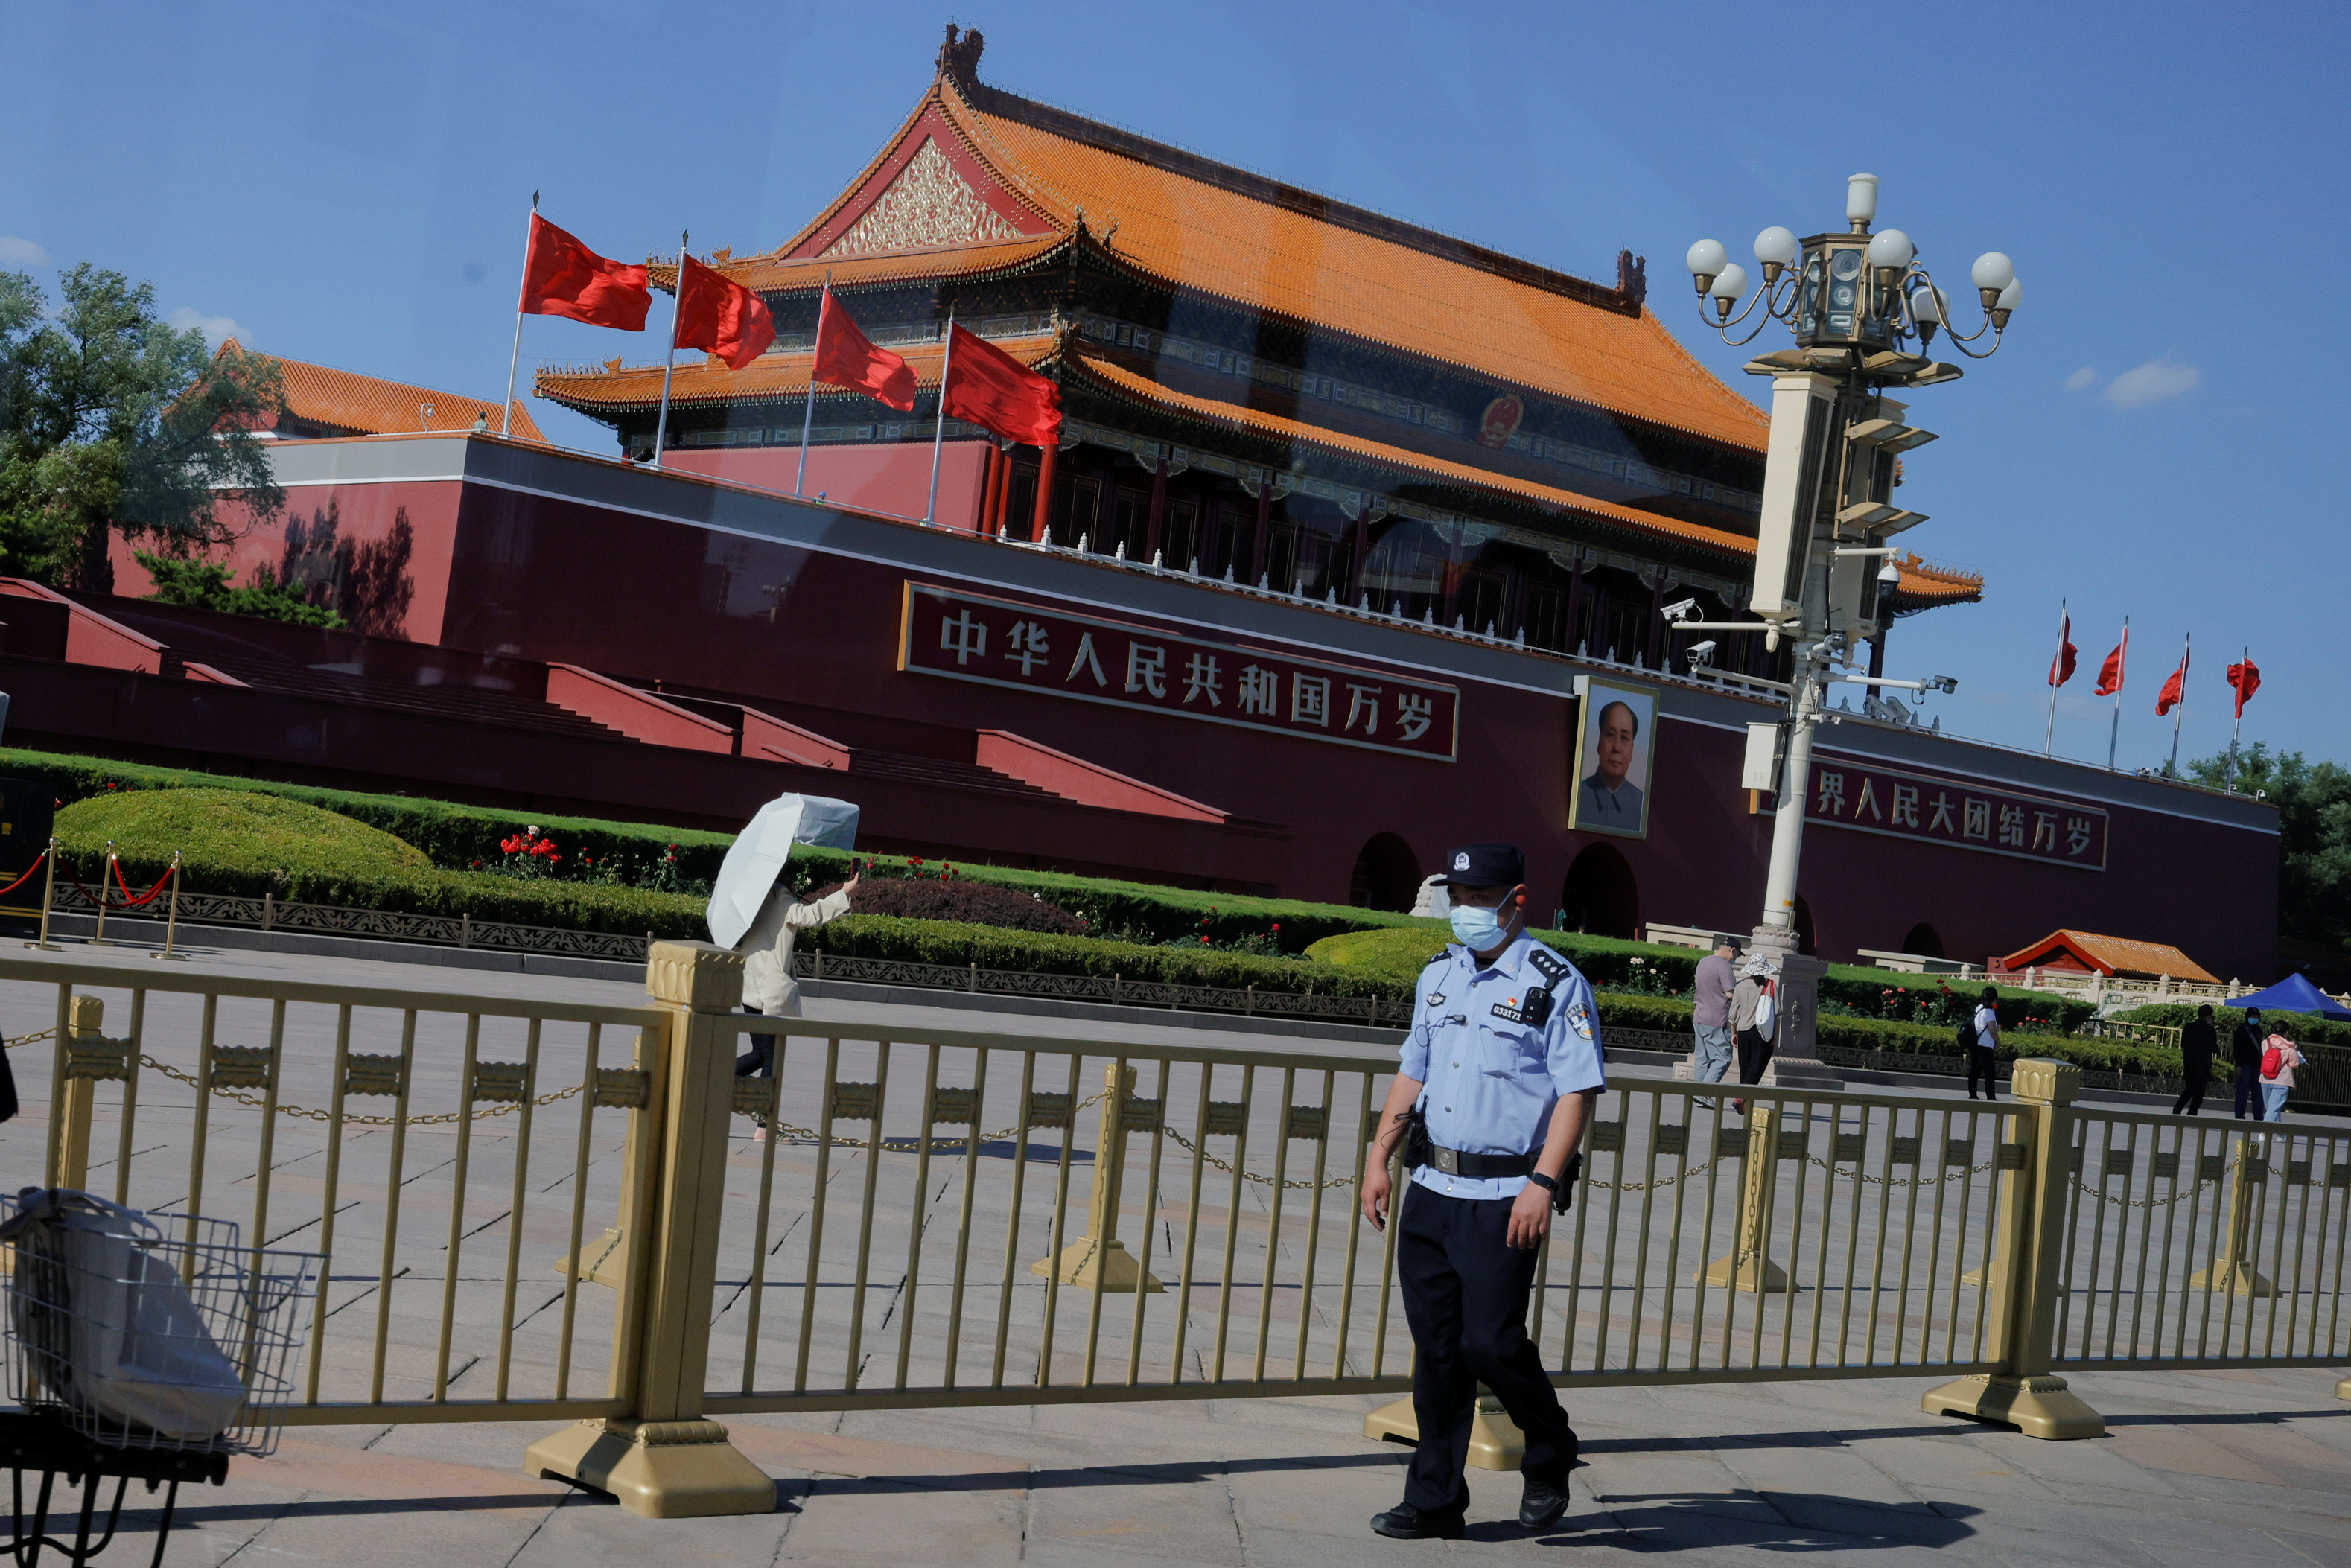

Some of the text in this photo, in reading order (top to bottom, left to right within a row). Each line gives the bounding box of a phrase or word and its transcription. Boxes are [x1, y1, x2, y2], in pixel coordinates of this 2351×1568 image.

[940, 609, 1433, 742] 中华人民共和国万岁
[1818, 769, 2091, 855] 界人民大团结万岁
[1493, 1006, 1521, 1021] 033171
